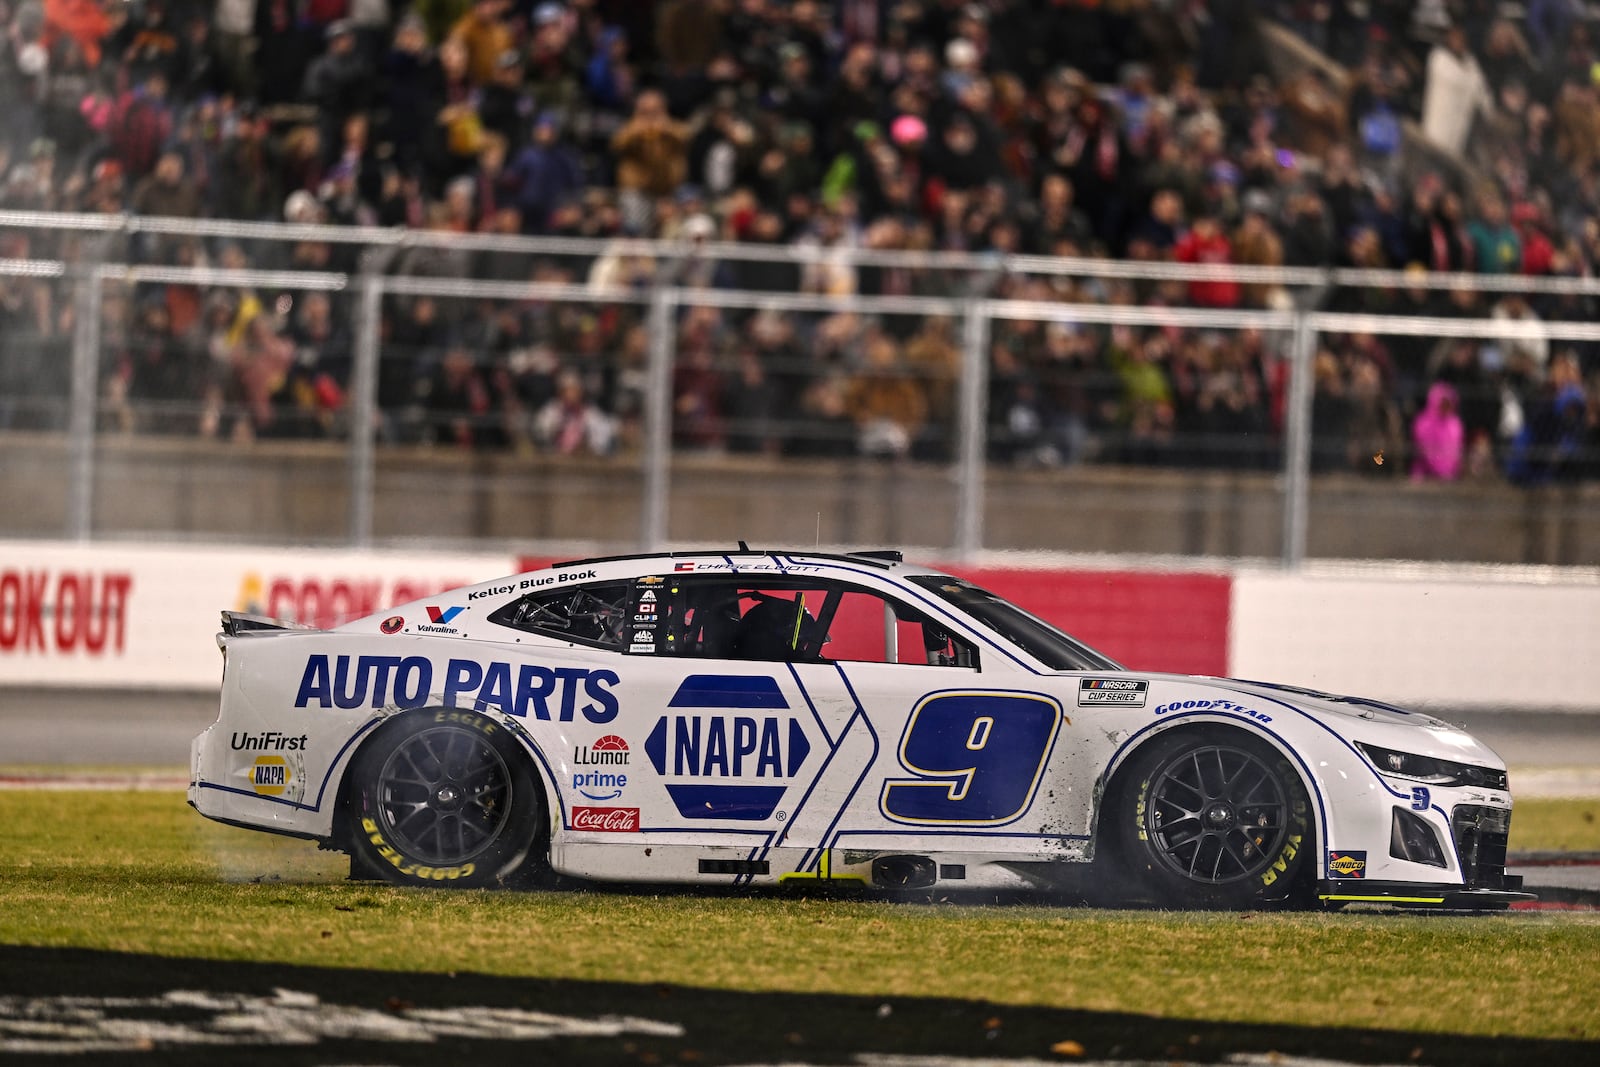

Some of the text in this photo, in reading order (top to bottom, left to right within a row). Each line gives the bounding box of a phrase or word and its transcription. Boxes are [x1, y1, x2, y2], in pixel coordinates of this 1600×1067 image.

[468, 584, 516, 600] Kelley
[520, 577, 554, 589] Blue
[558, 570, 596, 583] Book
[56, 573, 132, 655] OUT
[417, 624, 459, 634] Valvoline
[295, 654, 620, 724] AUTO PARTS
[1101, 681, 1138, 690] NASCAR
[1088, 692, 1137, 701] CUP SERIES
[231, 732, 307, 751] UniFirst
[674, 715, 783, 778] NAPA
[574, 746, 630, 765] LLumar
[878, 688, 1064, 827] 9
[255, 765, 285, 785] NAPA
[573, 770, 627, 789] prime
[1329, 860, 1364, 870] SUNOCO
